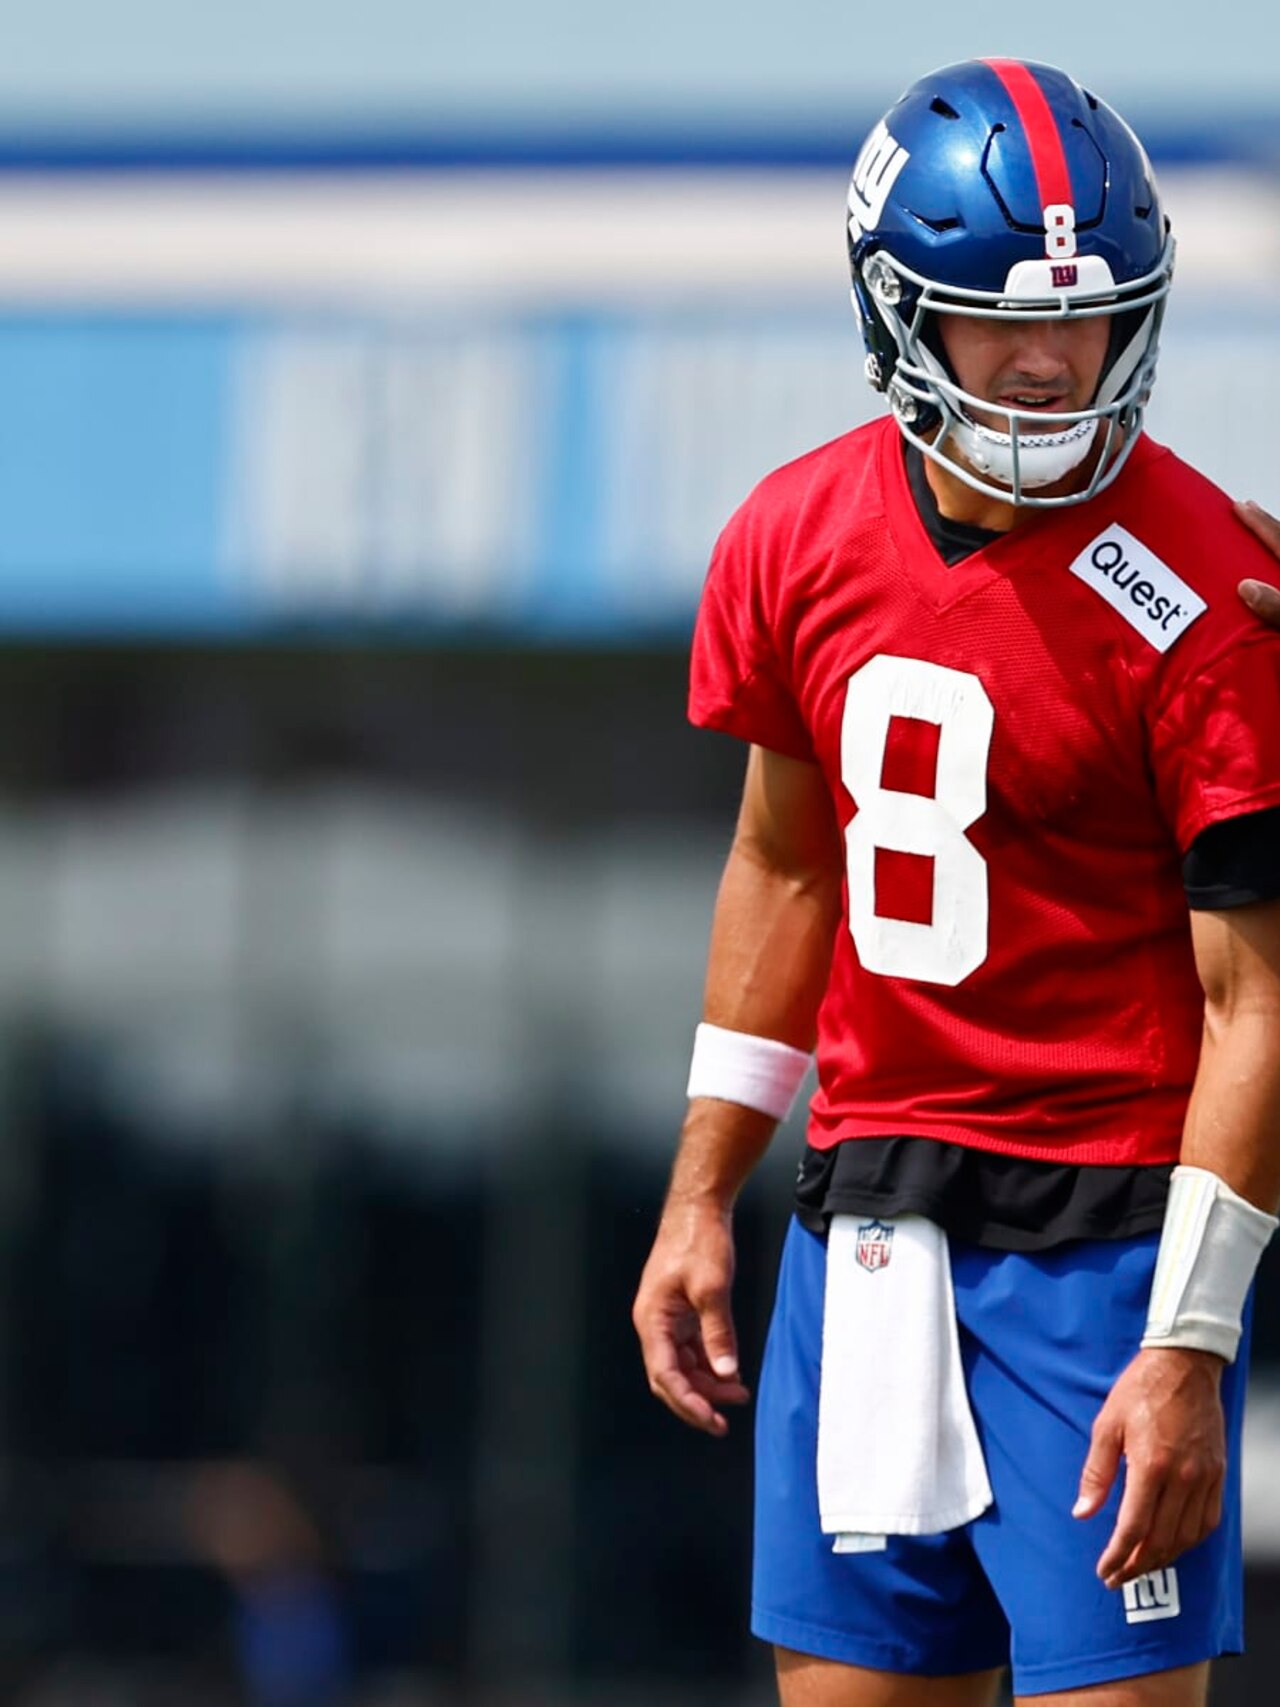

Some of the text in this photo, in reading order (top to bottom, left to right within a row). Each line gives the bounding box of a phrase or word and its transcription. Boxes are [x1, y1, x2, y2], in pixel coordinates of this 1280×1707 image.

[1043, 204, 1077, 258] 8
[1091, 541, 1181, 631] Quest
[840, 654, 995, 986] 8
[859, 1242, 891, 1267] NFL
